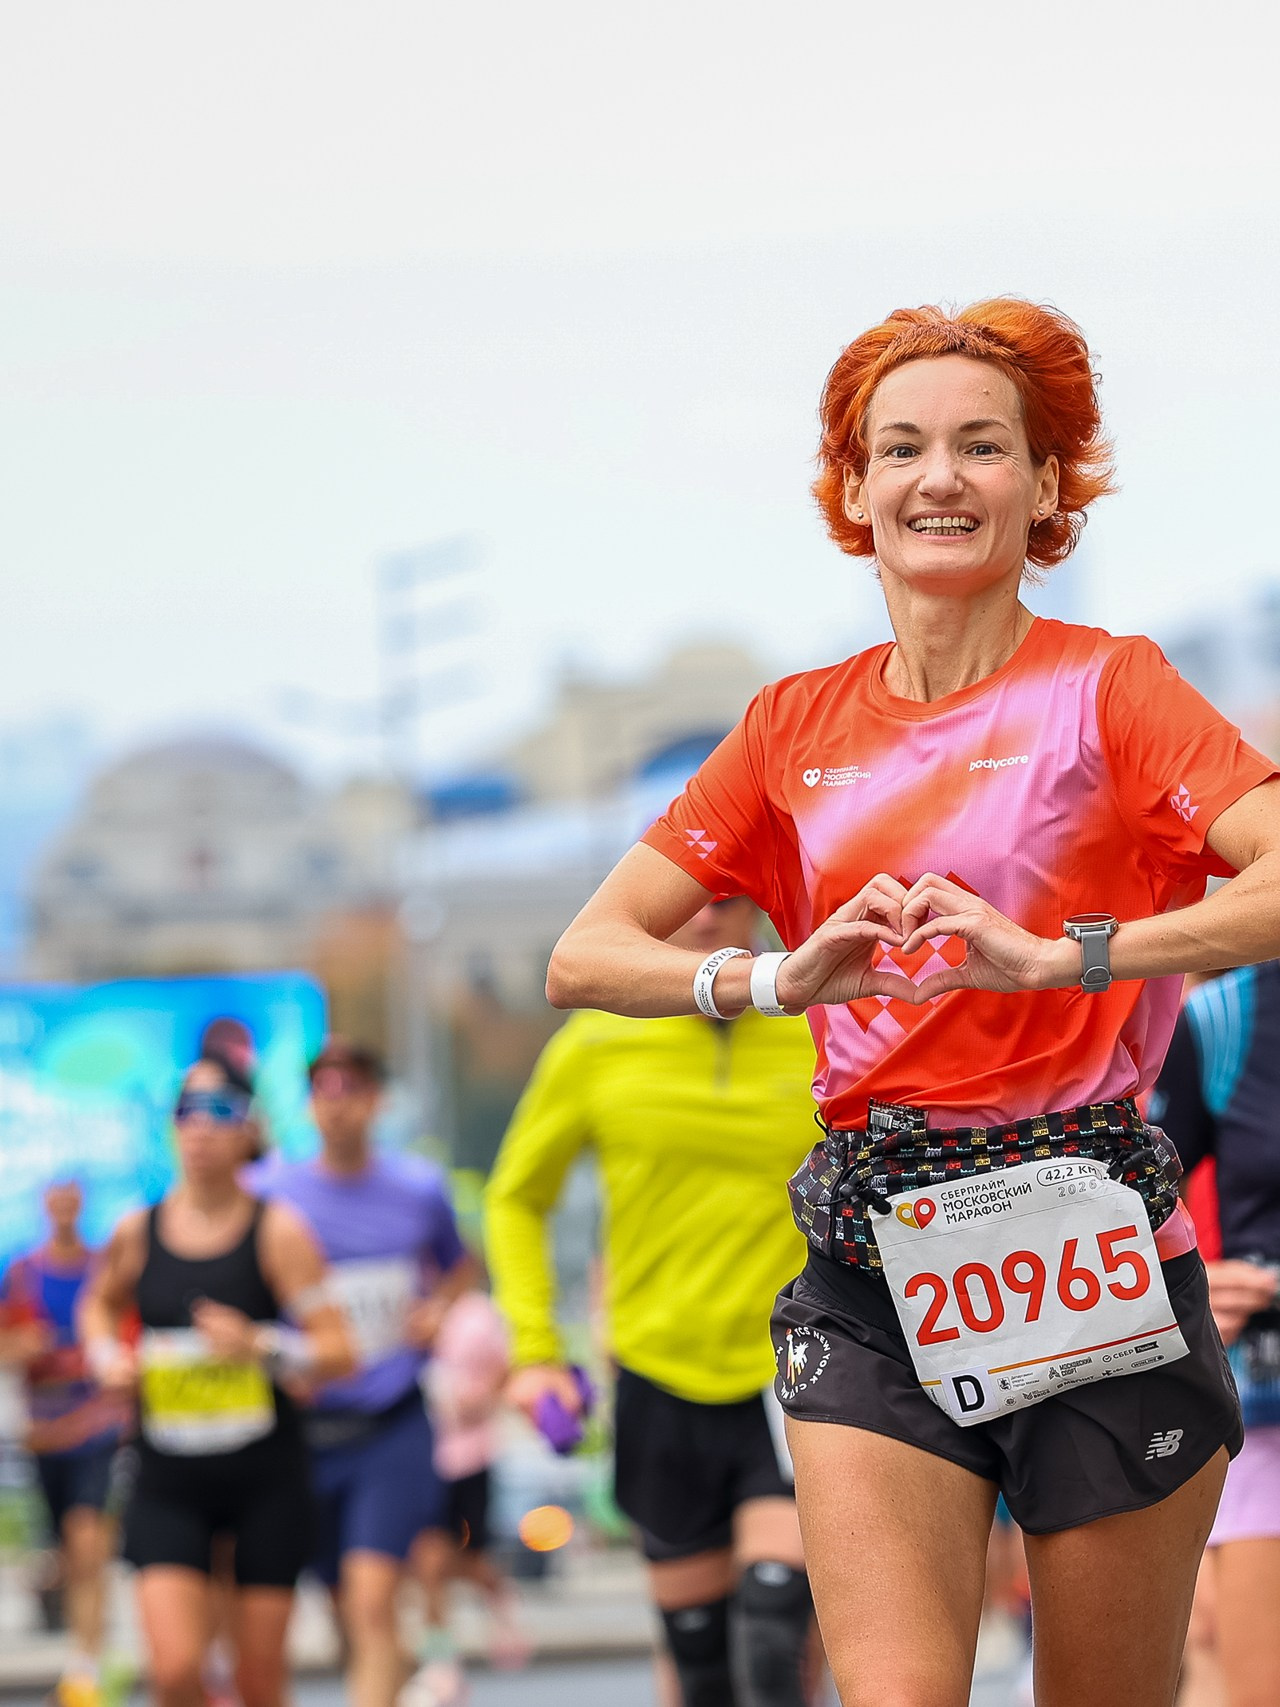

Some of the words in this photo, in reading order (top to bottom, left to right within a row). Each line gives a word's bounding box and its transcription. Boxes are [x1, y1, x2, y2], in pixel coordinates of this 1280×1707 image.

[968, 754, 1029, 771] bodycore
[971, 1137, 987, 1145] RUN
[1044, 1166, 1074, 1181] 42,2
[940, 1179, 1006, 1201] СБЕРПРАЙМ
[943, 1182, 1033, 1213] МОСКОВСКИЙ
[1058, 1179, 1098, 1198] 2026
[946, 1200, 1013, 1225] МАРАФОН
[904, 1224, 1151, 1347] 20965
[794, 1327, 811, 1337] TCS
[813, 1330, 832, 1352] NEW
[1112, 1349, 1134, 1359] СБЕР
[809, 1353, 832, 1385] YORK
[951, 1374, 985, 1413] D
